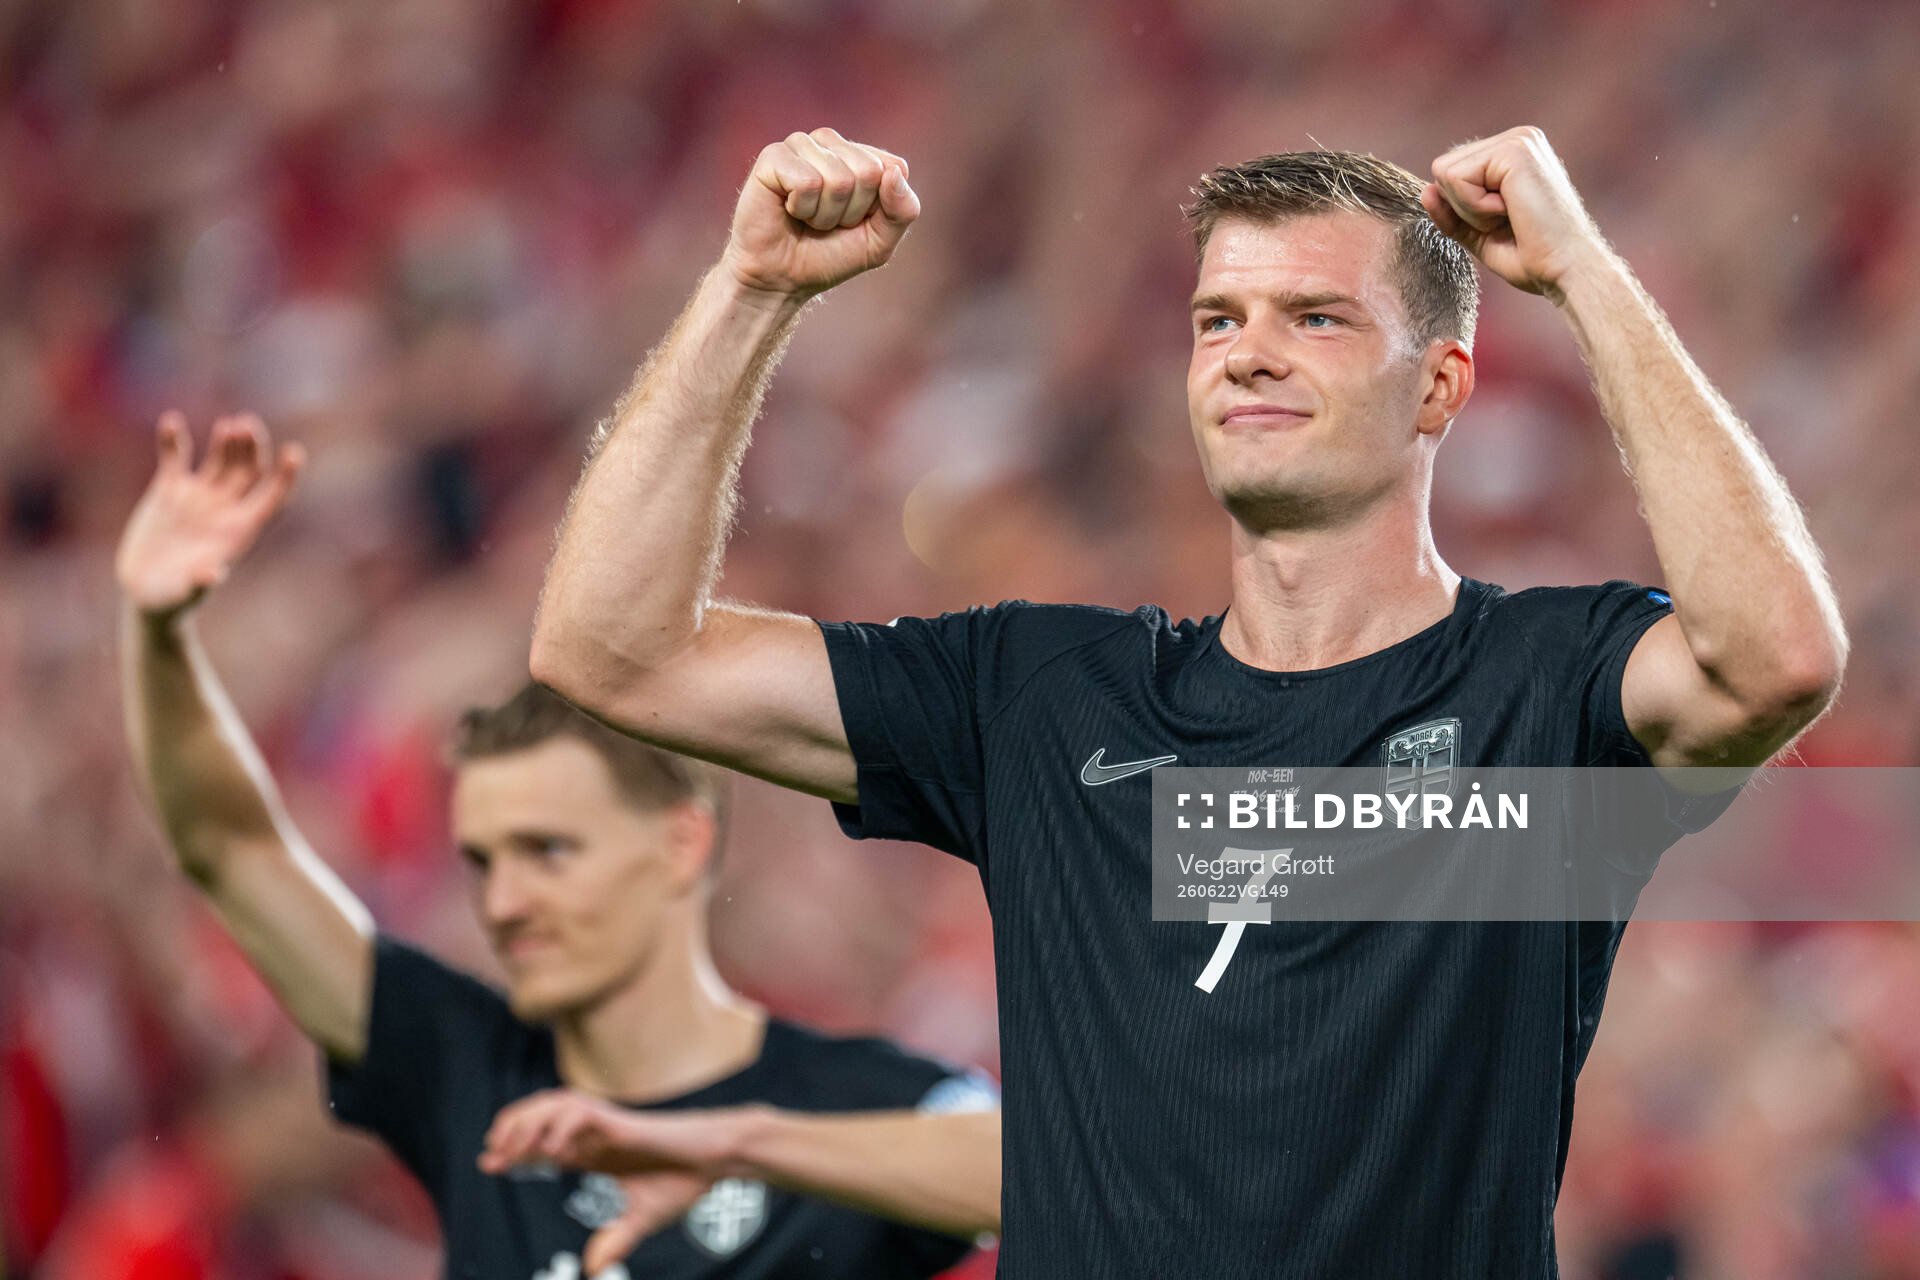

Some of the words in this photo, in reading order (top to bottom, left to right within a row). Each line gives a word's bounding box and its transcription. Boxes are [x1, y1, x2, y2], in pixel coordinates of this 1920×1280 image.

[1409, 729, 1433, 743] NORGE
[1247, 768, 1294, 783] NOR-SEN
[1194, 846, 1294, 994] 7
